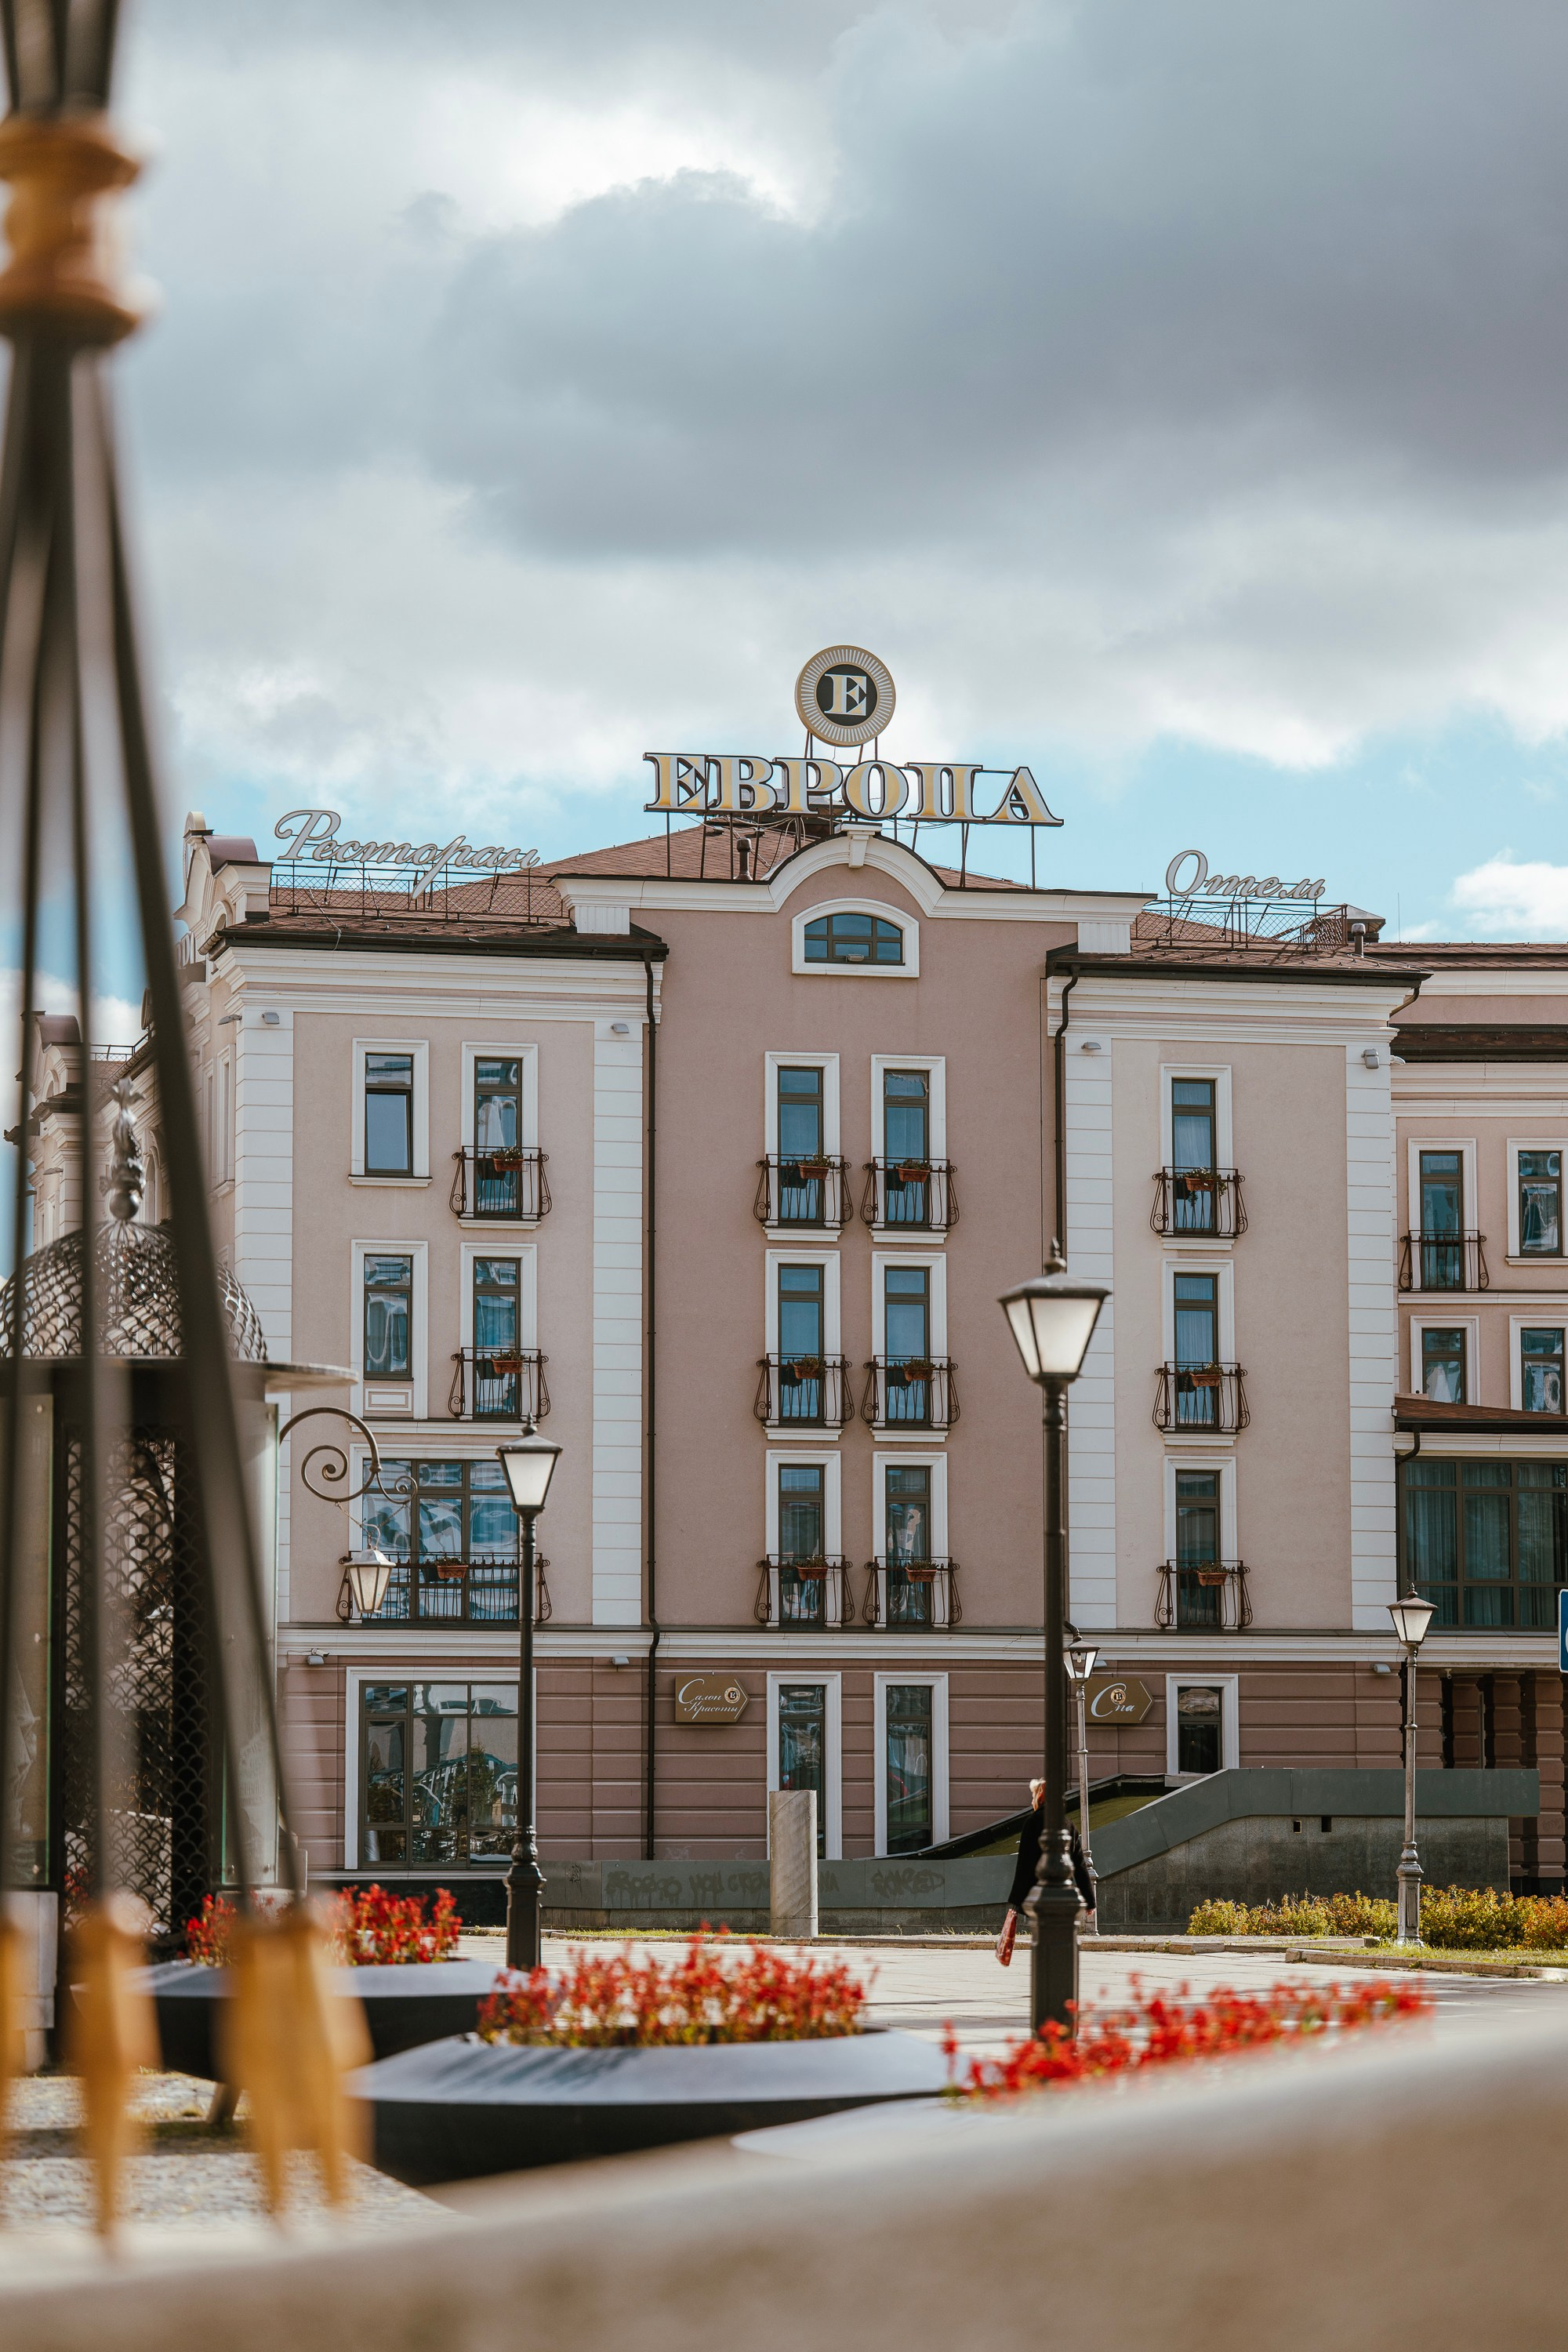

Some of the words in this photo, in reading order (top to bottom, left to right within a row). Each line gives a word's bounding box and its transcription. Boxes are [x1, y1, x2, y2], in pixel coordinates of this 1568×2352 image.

[824, 673, 867, 717] Е
[642, 751, 1065, 826] ЕВРОПА
[274, 809, 541, 899] Ресторан
[1165, 849, 1326, 900] Отель
[678, 1679, 722, 1704] Салон
[684, 1700, 738, 1719] Красоты
[1091, 1682, 1135, 1718] Спа
